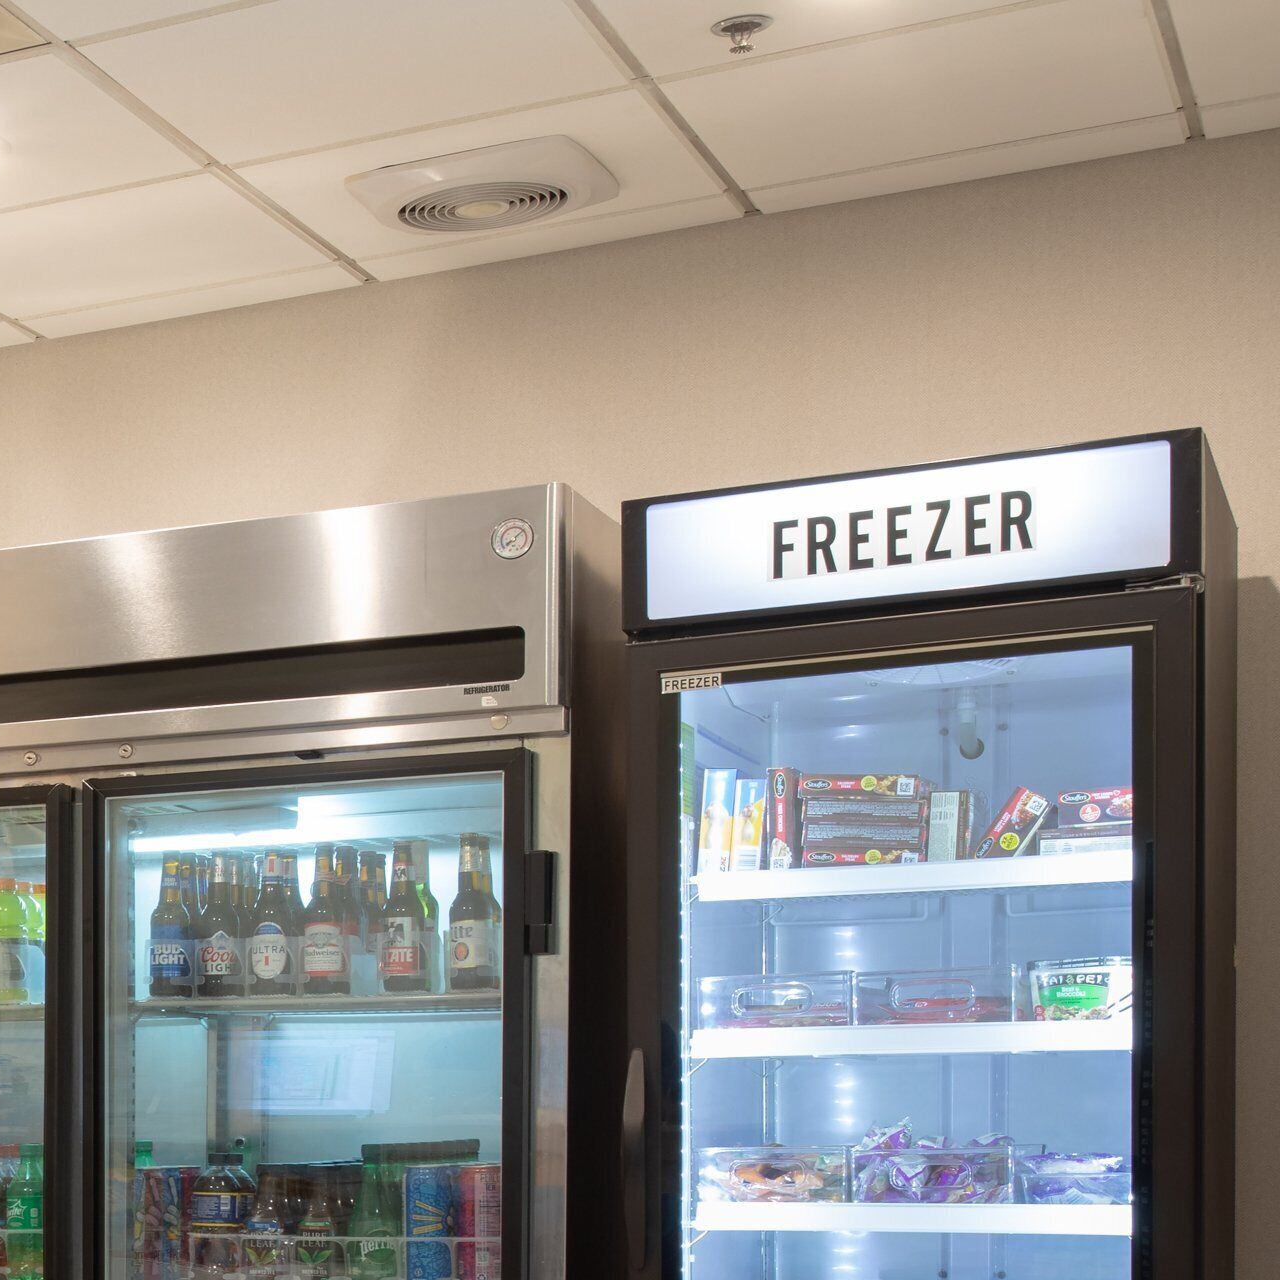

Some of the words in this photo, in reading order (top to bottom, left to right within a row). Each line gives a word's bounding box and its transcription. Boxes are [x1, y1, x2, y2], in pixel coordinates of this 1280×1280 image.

[772, 490, 1033, 580] FREEZER
[663, 675, 720, 692] FREEZER
[154, 944, 182, 955] BUD
[200, 946, 235, 964] Coor
[252, 946, 286, 954] ULTRA
[150, 954, 186, 964] LIGHT
